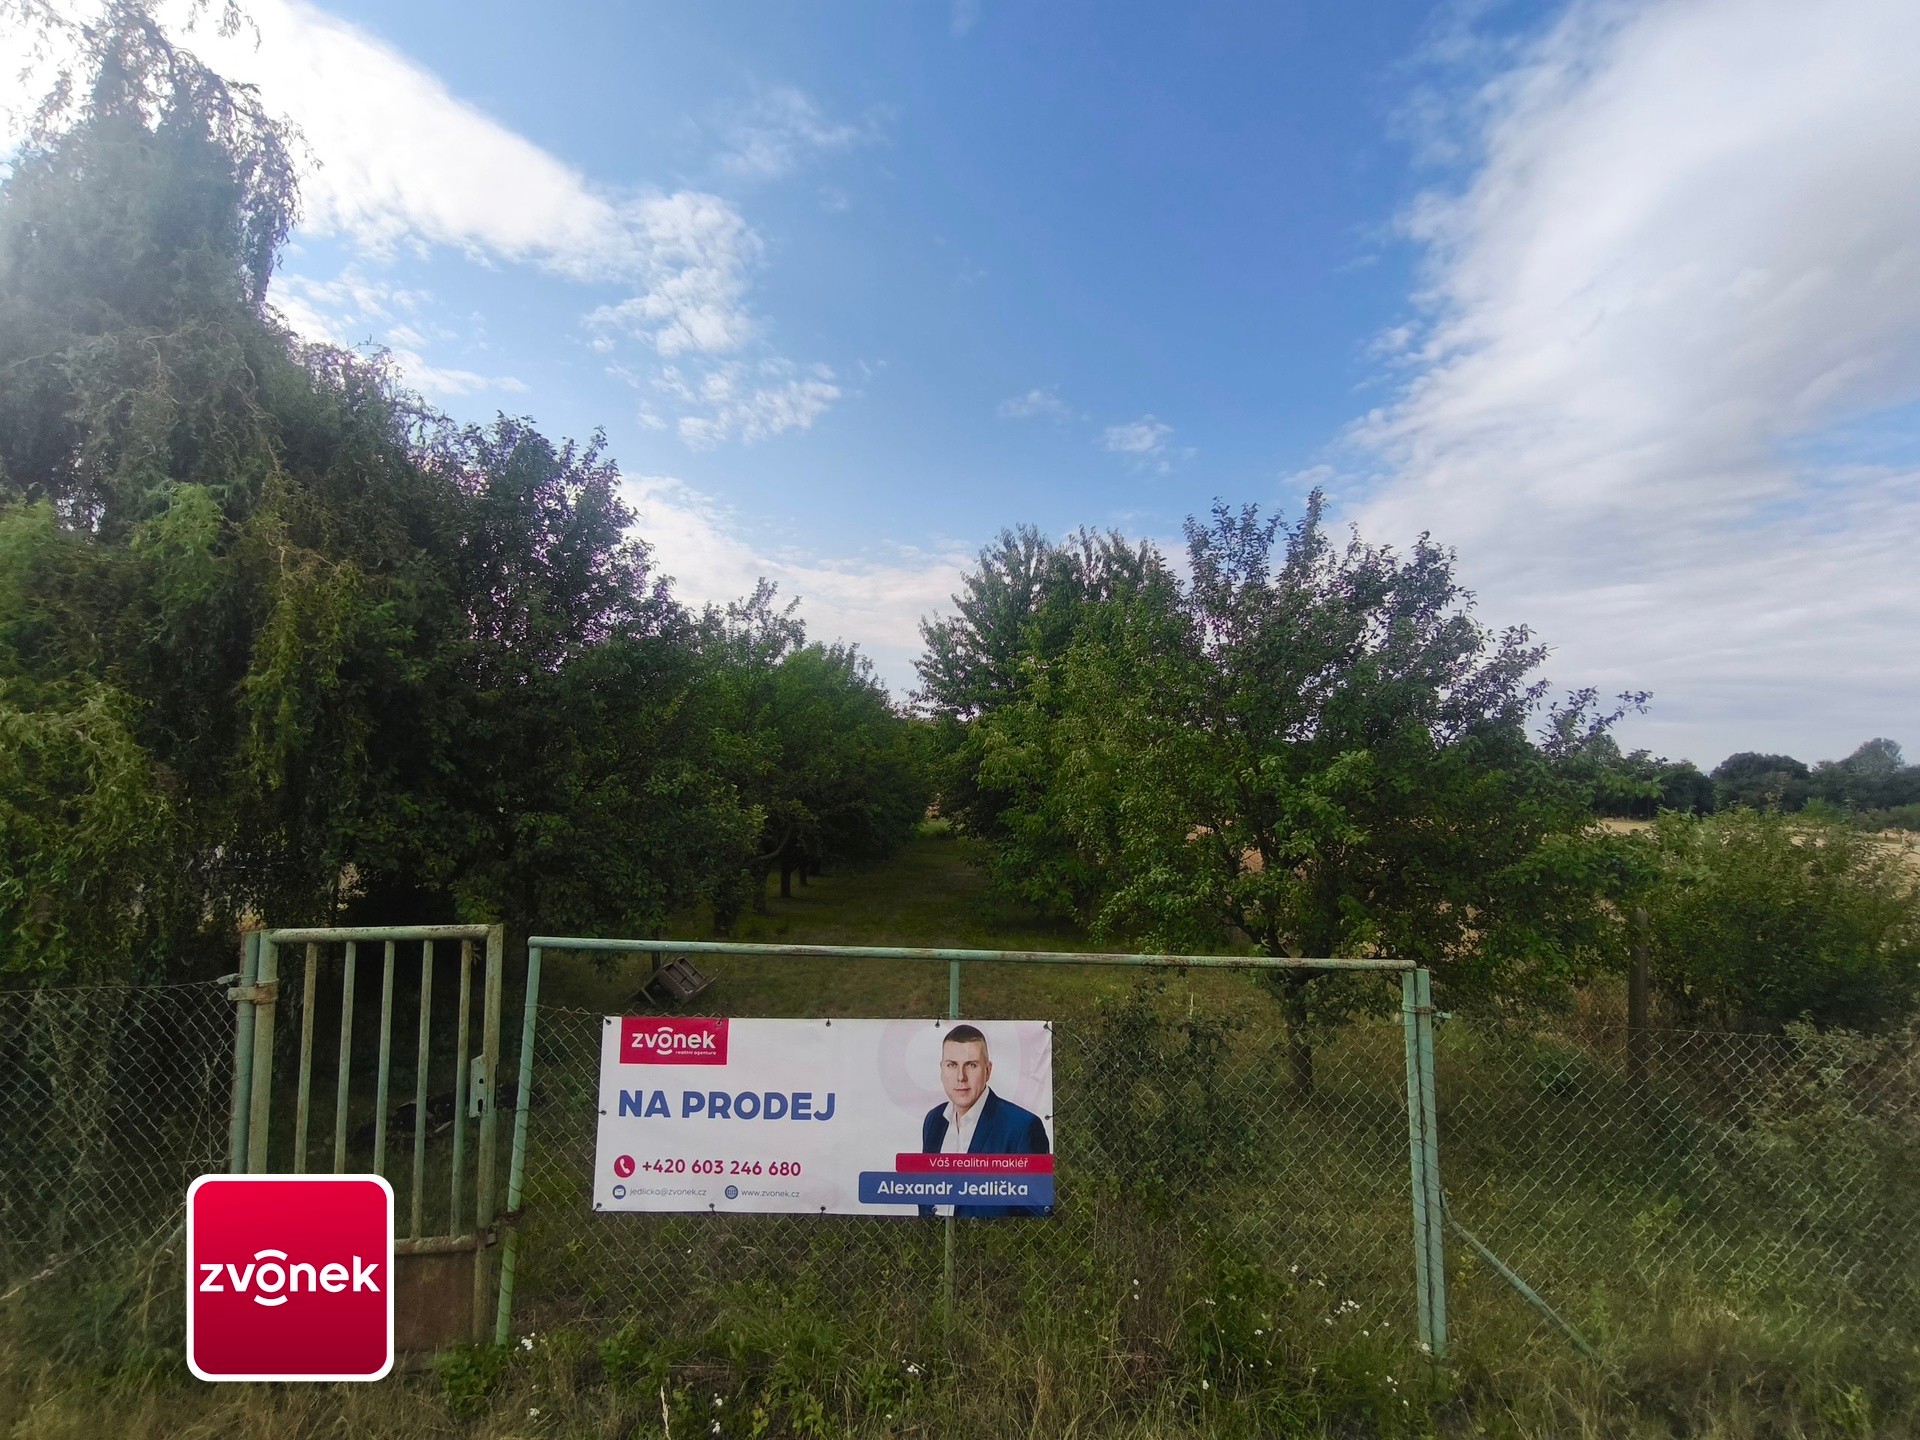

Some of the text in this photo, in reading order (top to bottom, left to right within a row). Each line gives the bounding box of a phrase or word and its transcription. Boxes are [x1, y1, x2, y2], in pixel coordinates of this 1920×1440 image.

[632, 1029, 716, 1051] zvonek
[618, 1090, 836, 1121] NA PRODEJ
[642, 1159, 802, 1176] +420 603 246 680
[929, 1157, 1029, 1168] Váš realitní makléř
[629, 1187, 707, 1198] jedlicka@zvonek.cz
[741, 1188, 800, 1198] www.zvonek.cz
[877, 1180, 1028, 1196] Alexandr Jedlička
